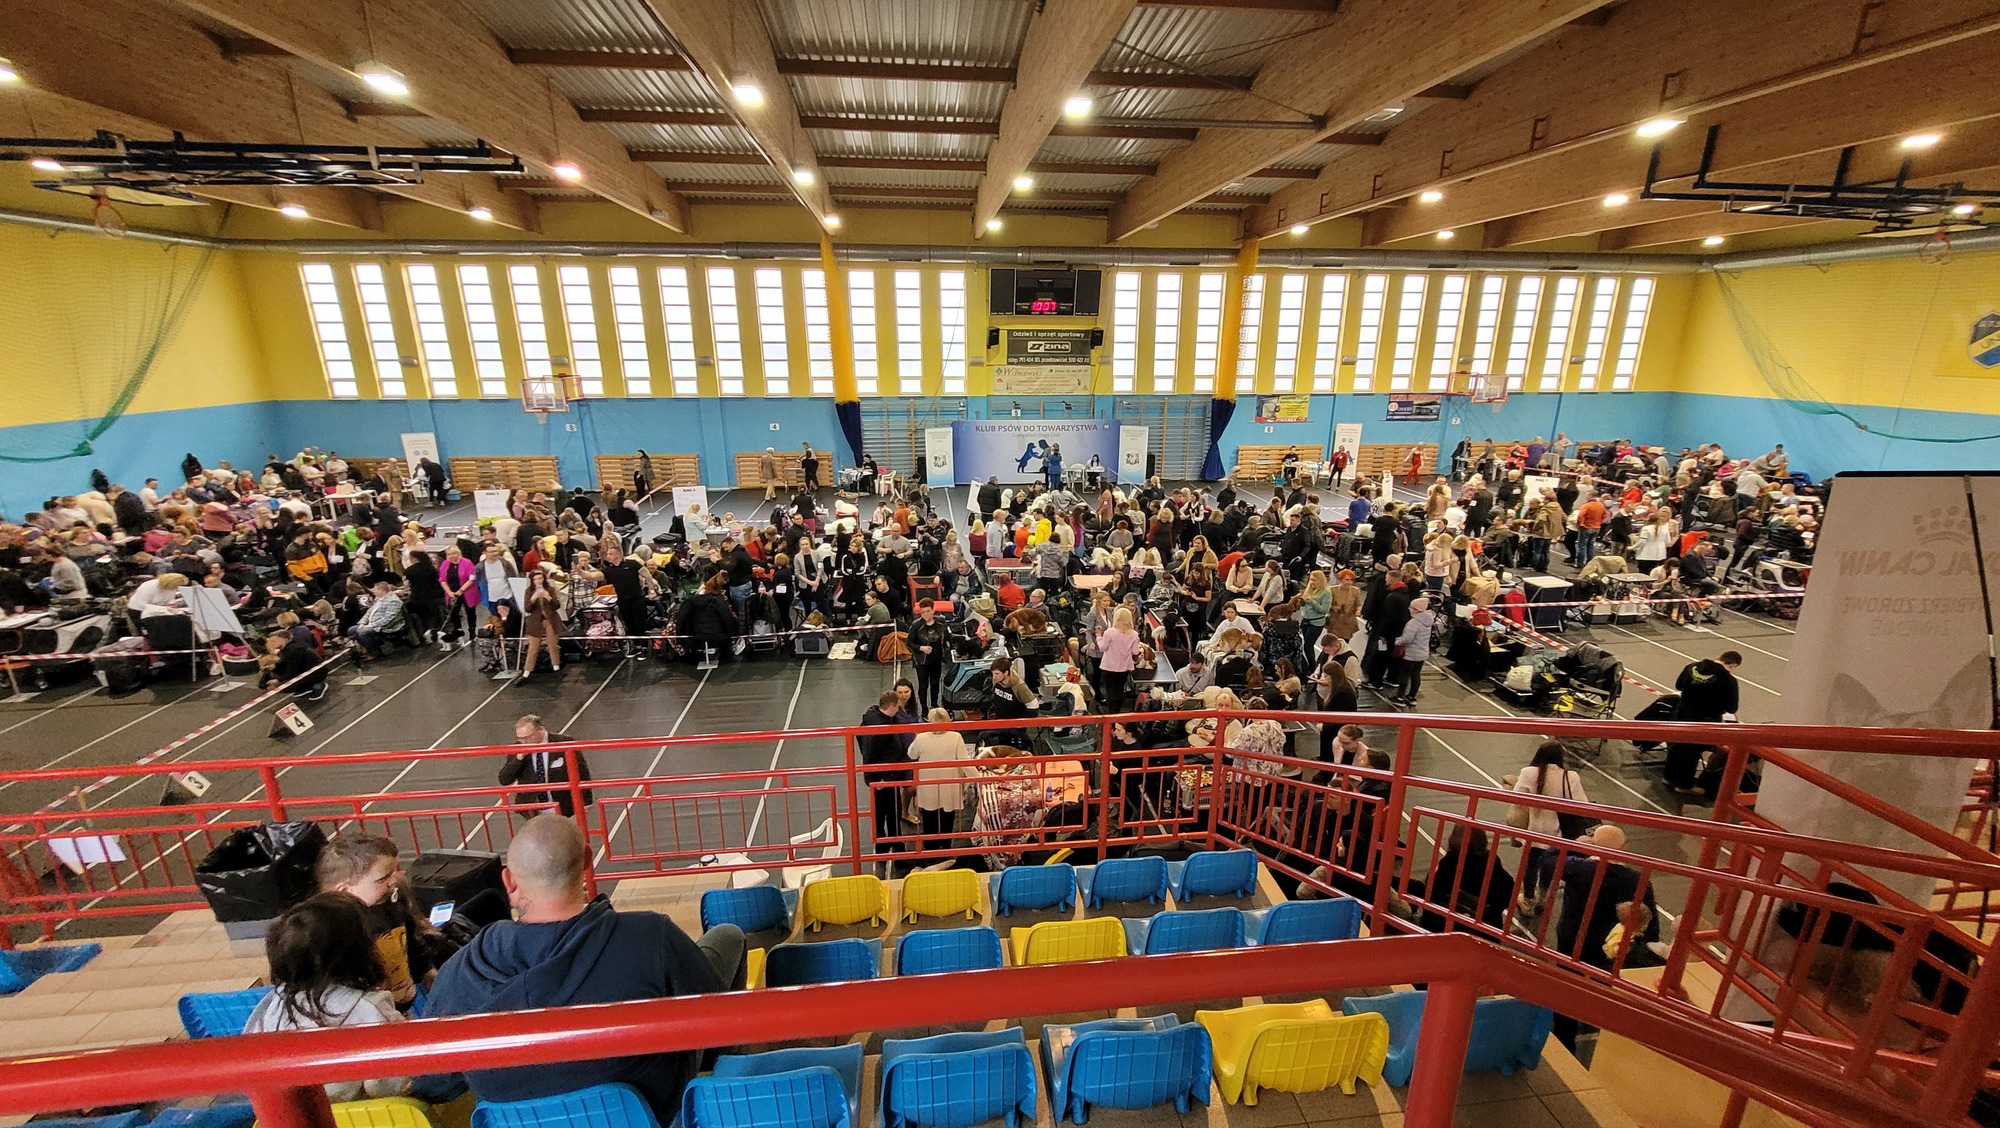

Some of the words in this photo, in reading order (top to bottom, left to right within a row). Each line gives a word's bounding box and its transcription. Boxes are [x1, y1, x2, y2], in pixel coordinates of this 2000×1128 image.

[998, 424, 1022, 432] PSÓW
[1023, 424, 1035, 432] DO
[1037, 424, 1098, 432] TOWARZYSTWA
[293, 716, 306, 728] 4
[188, 776, 204, 790] 3
